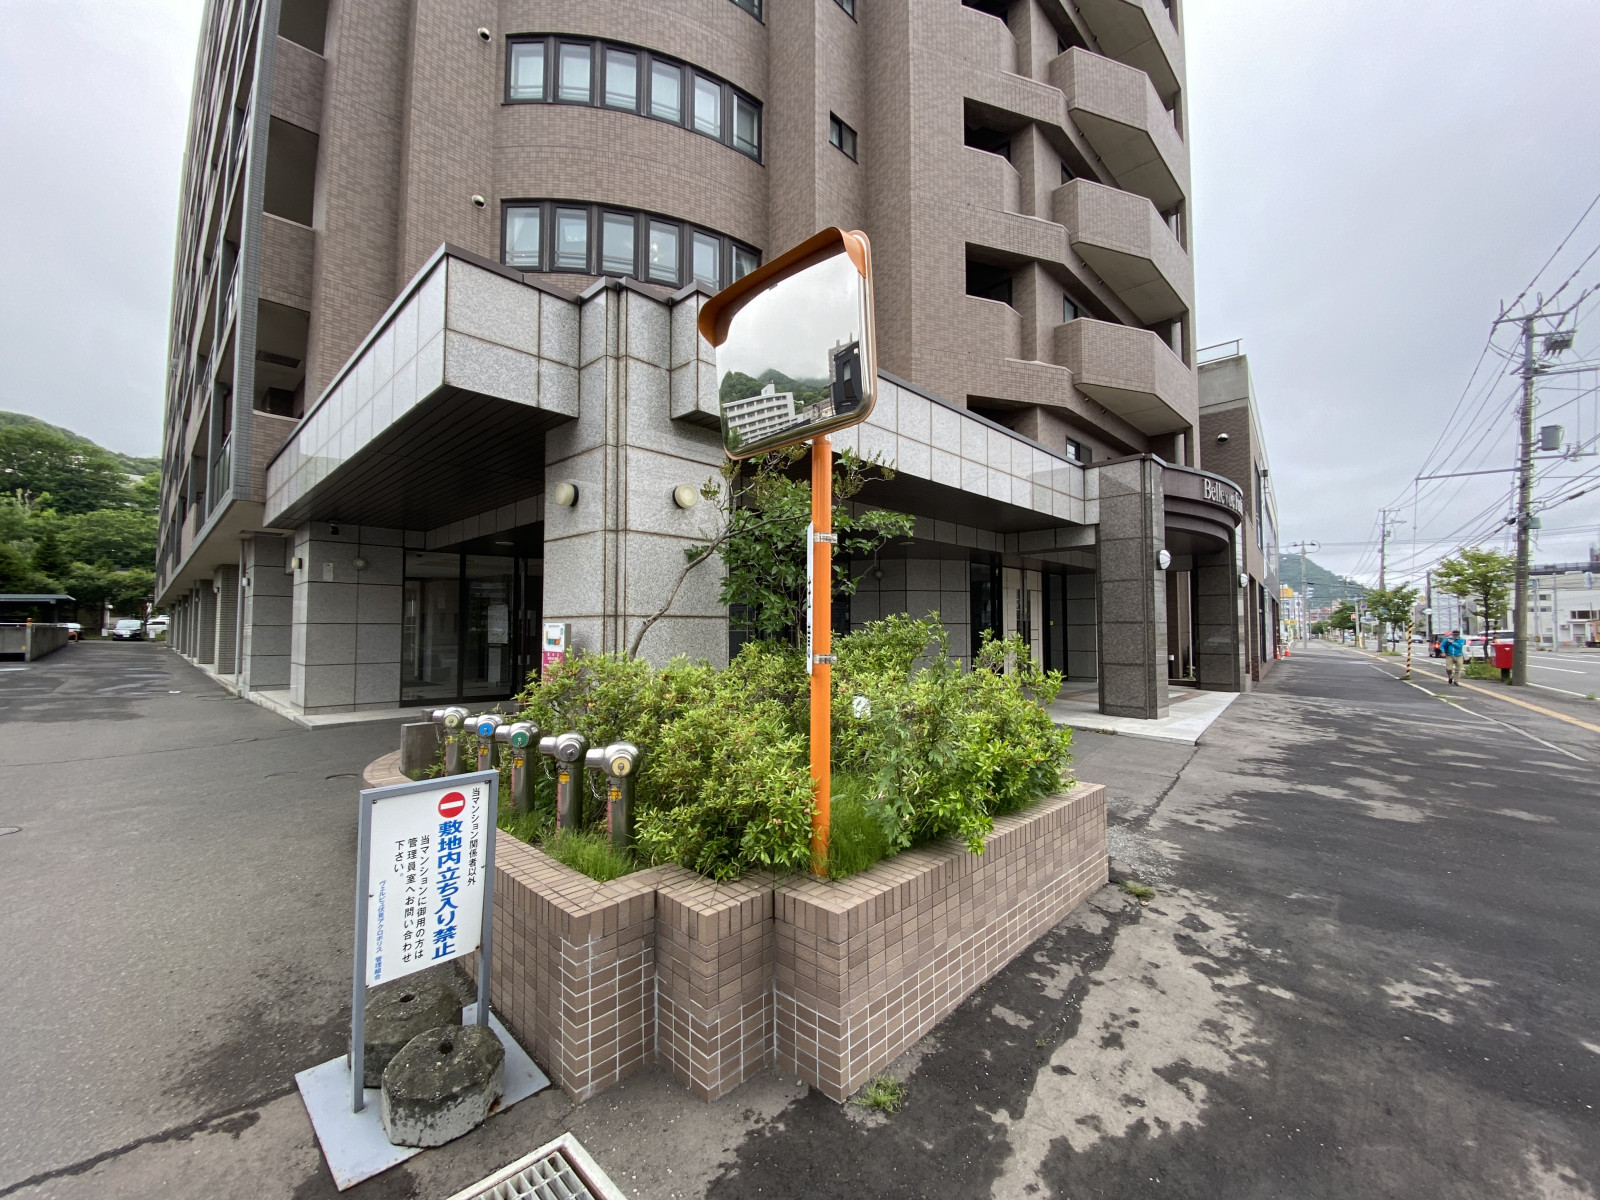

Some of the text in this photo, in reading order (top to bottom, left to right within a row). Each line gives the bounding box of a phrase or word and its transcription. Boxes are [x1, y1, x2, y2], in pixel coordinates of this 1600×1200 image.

[394, 839, 405, 877] 下さい。
[414, 834, 430, 960] 当マンションに御用の方は
[432, 819, 463, 960] 敷地内立ち入り禁止
[467, 787, 480, 886] 当マンション関係者以外
[402, 837, 418, 963] 管理員室へお問い合わせ
